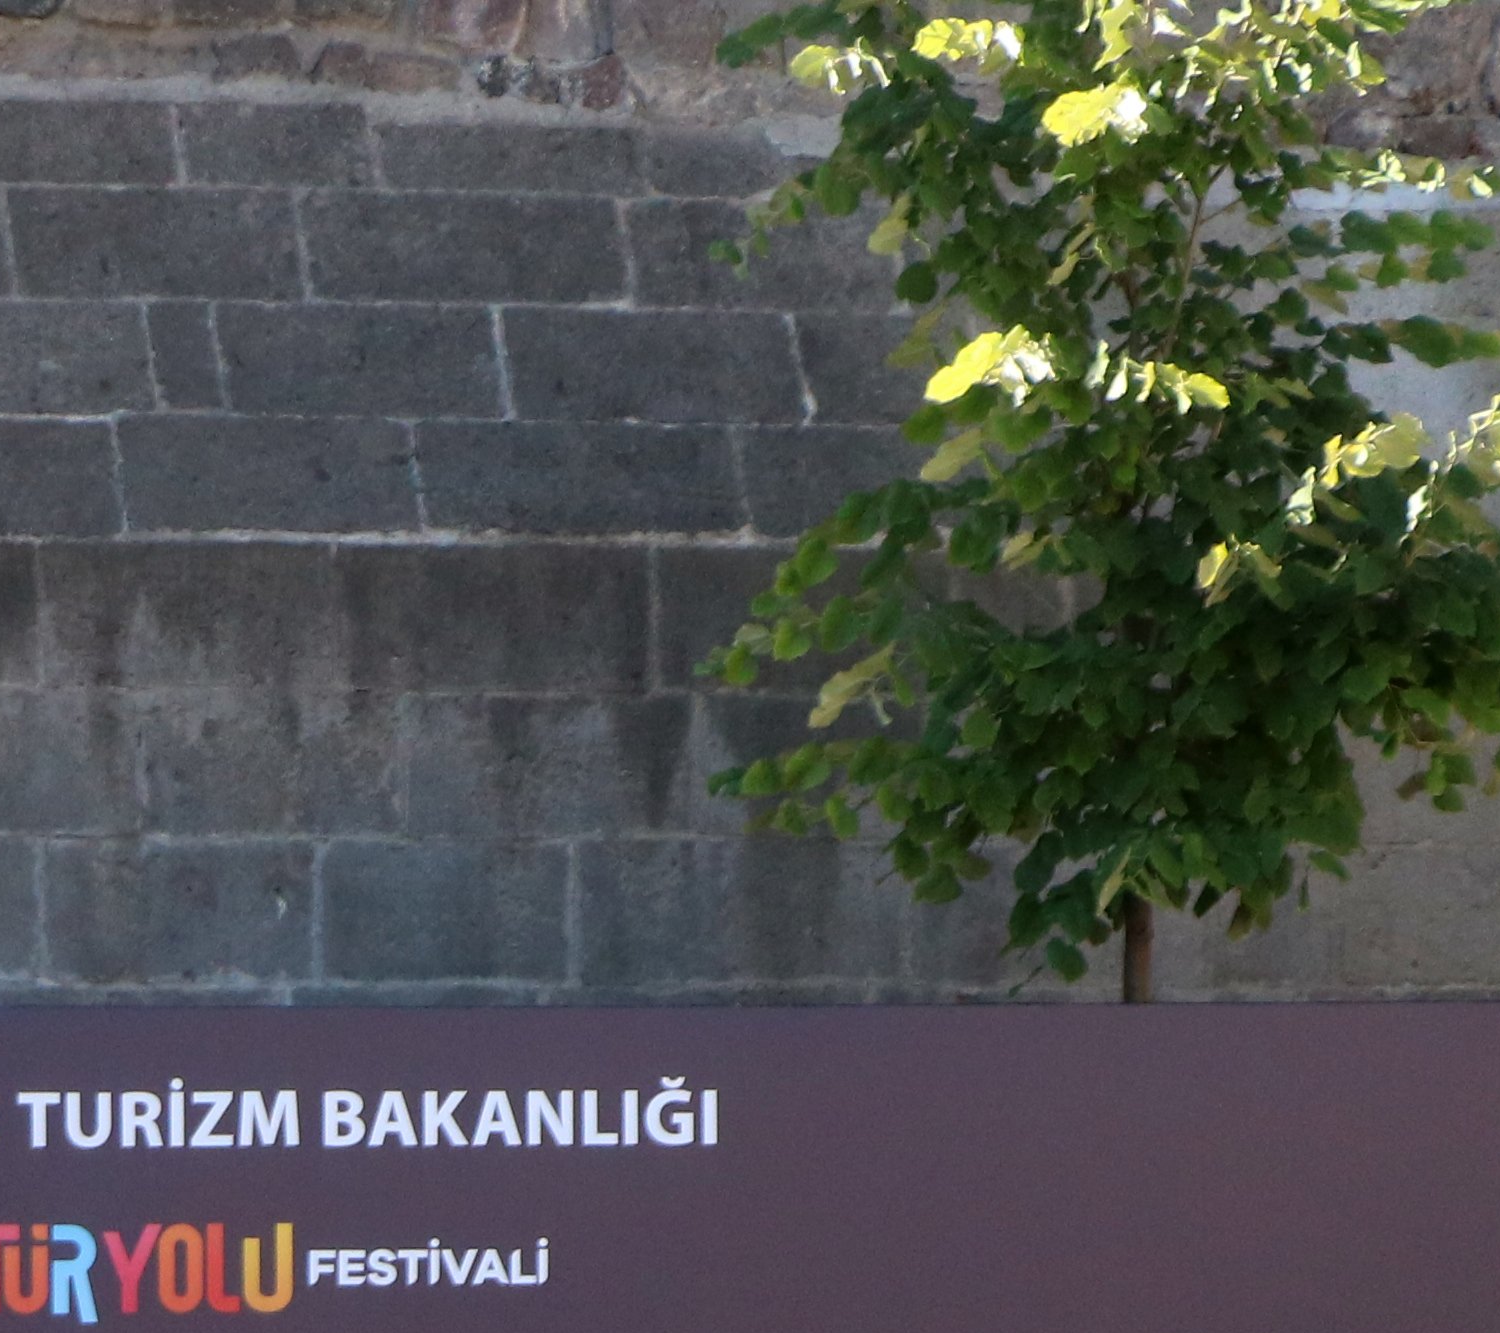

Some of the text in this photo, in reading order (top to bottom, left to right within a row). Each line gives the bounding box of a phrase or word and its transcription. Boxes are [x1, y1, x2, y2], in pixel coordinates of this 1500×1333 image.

[18, 1077, 301, 1150] TURİZM
[322, 1077, 719, 1149] BAKANLIĞI
[103, 1222, 294, 1316] YOLU
[308, 1238, 550, 1287] FESTİVALİ
